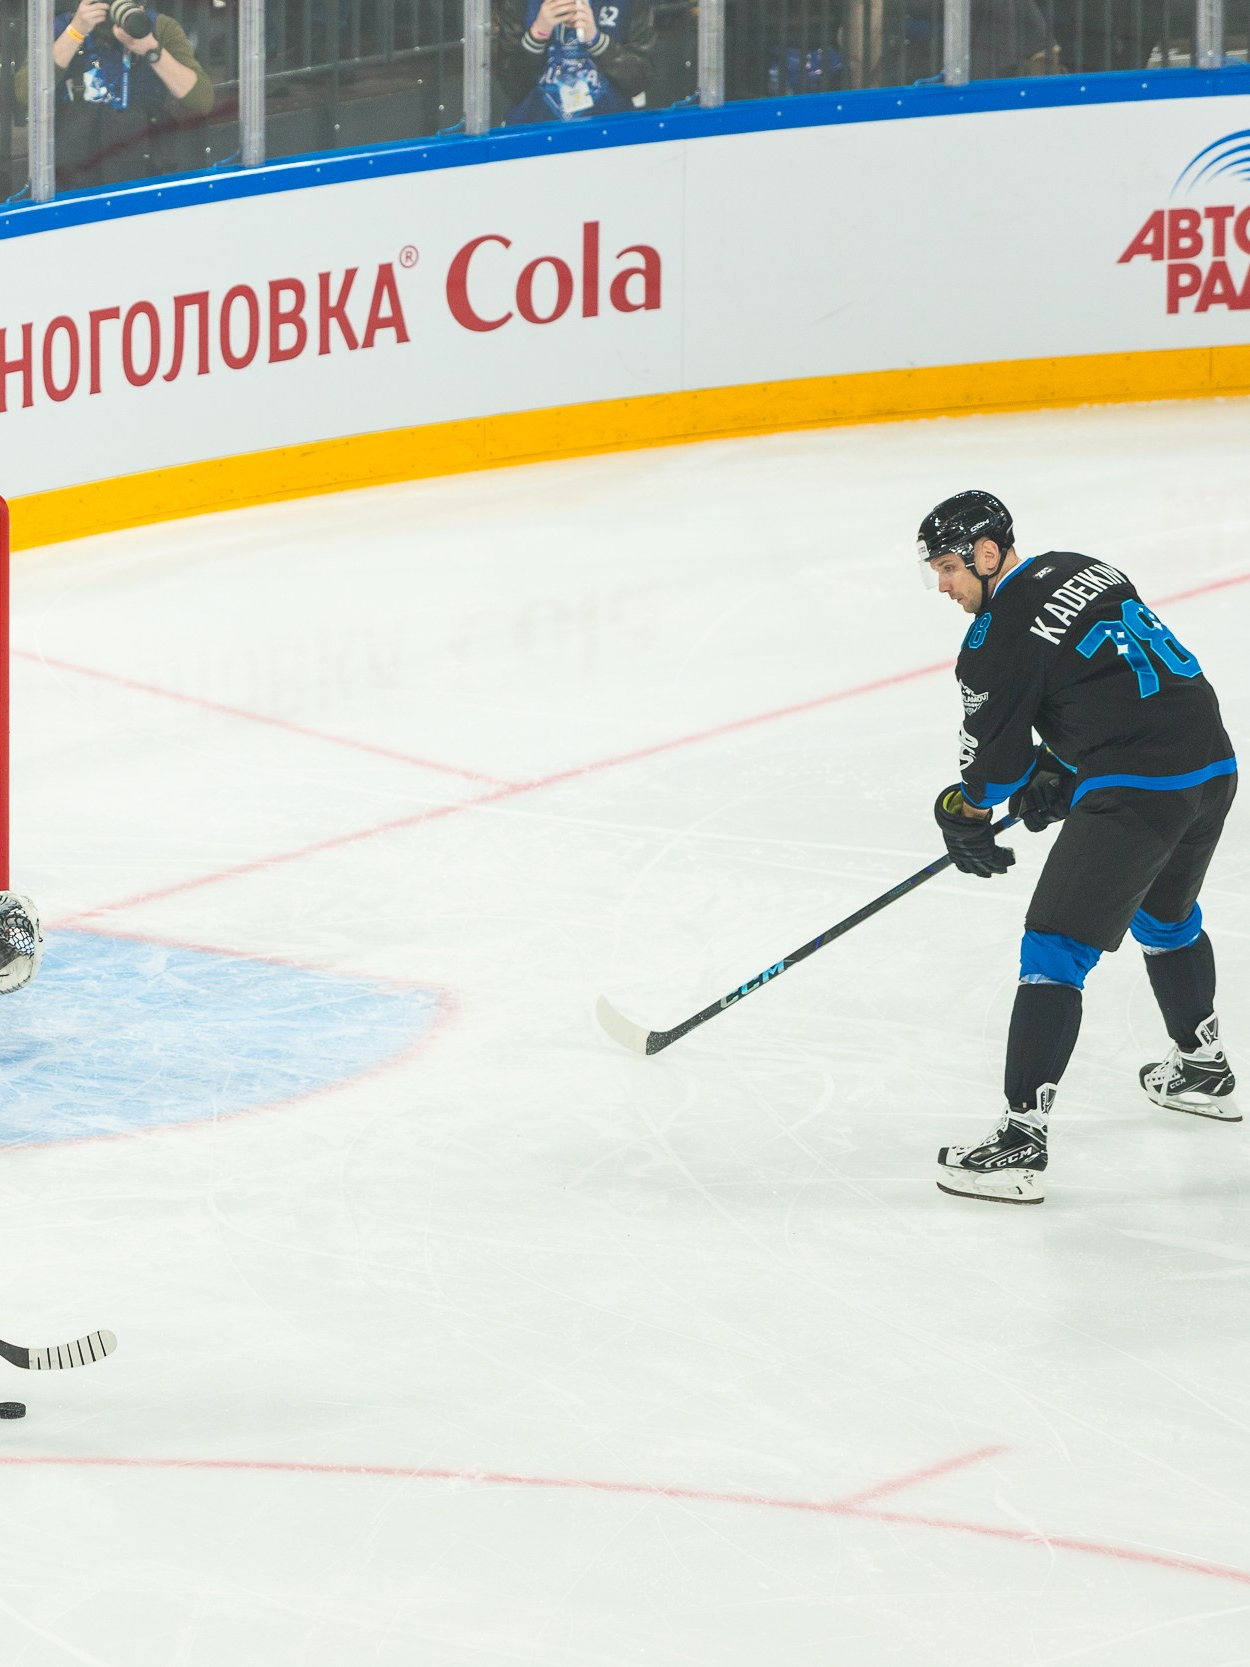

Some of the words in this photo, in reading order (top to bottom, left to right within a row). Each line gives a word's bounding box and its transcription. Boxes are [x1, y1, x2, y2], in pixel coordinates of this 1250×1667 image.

[446, 221, 661, 333] Cola
[969, 518, 990, 533] CCM
[1029, 563, 1128, 645] KADEIKIN
[1075, 599, 1203, 699] 78
[720, 959, 785, 1009] CCM
[1170, 1077, 1186, 1089] CCM
[985, 1146, 1033, 1168] CCM
